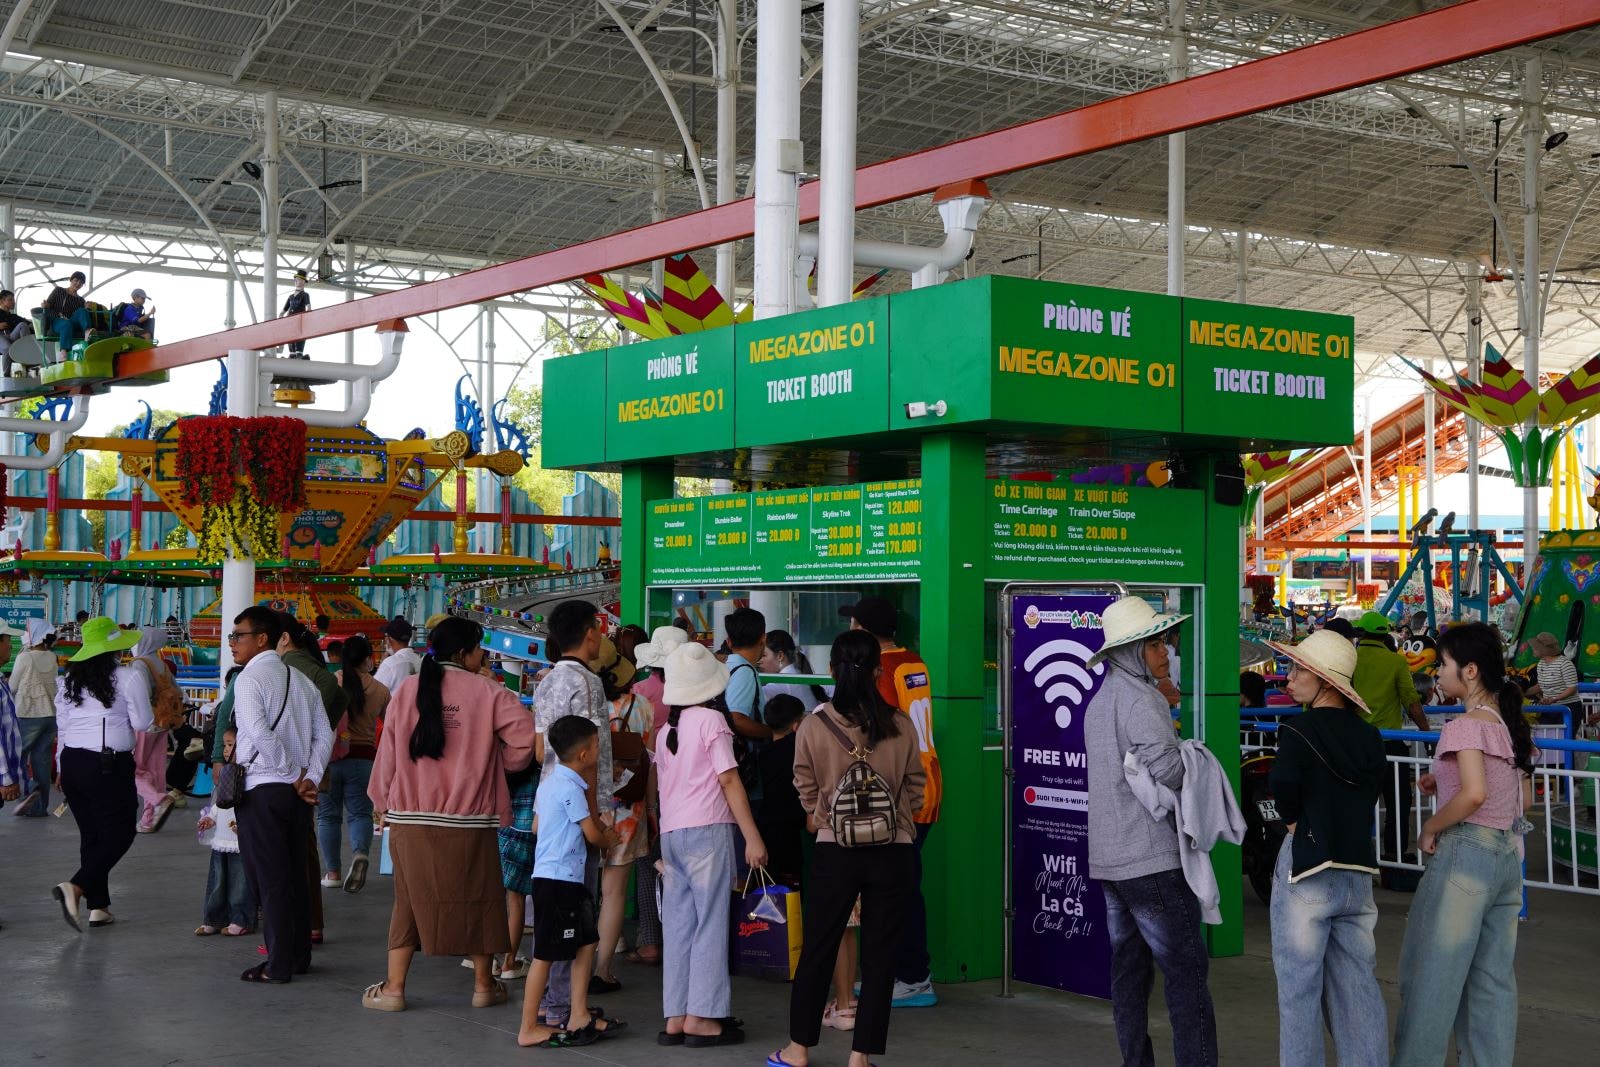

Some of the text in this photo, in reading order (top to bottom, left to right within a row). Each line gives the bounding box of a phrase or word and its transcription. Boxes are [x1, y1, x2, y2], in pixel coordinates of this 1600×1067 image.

[1044, 300, 1131, 337] PHÒNG VÉ
[749, 326, 846, 364] MEGAZONE
[1190, 320, 1320, 356] MEGAZONE
[648, 346, 698, 380] PHÒNG VÉ
[1000, 346, 1139, 384] MEGAZONE
[767, 369, 852, 403] TICKET BOOTH
[1214, 367, 1325, 399] TICKET BOOTH
[618, 392, 701, 423] MEGAZONE
[1010, 485, 1020, 498] XE
[1023, 483, 1042, 499] THỜI
[1046, 488, 1066, 501] GIAN
[1074, 488, 1128, 504] XE VƯỢT DỐC
[888, 500, 918, 514] 120.000
[1000, 504, 1057, 517] Time Carriage
[1068, 507, 1136, 521] Train Over Slope
[718, 532, 740, 544] 20.000
[770, 529, 792, 542] 20.000
[829, 526, 853, 539] 30.000
[889, 522, 915, 536] 80.000
[1014, 523, 1047, 537] 20.000
[1086, 526, 1117, 539] 20.000
[666, 535, 686, 547] 20.000
[828, 543, 853, 556] 20.000
[886, 539, 916, 554] 170.000
[1024, 748, 1086, 768] FREE WI
[1043, 854, 1077, 875] Wifi
[1066, 875, 1088, 898] Mà
[1042, 893, 1084, 917] La Cà
[1033, 912, 1063, 934] Check
